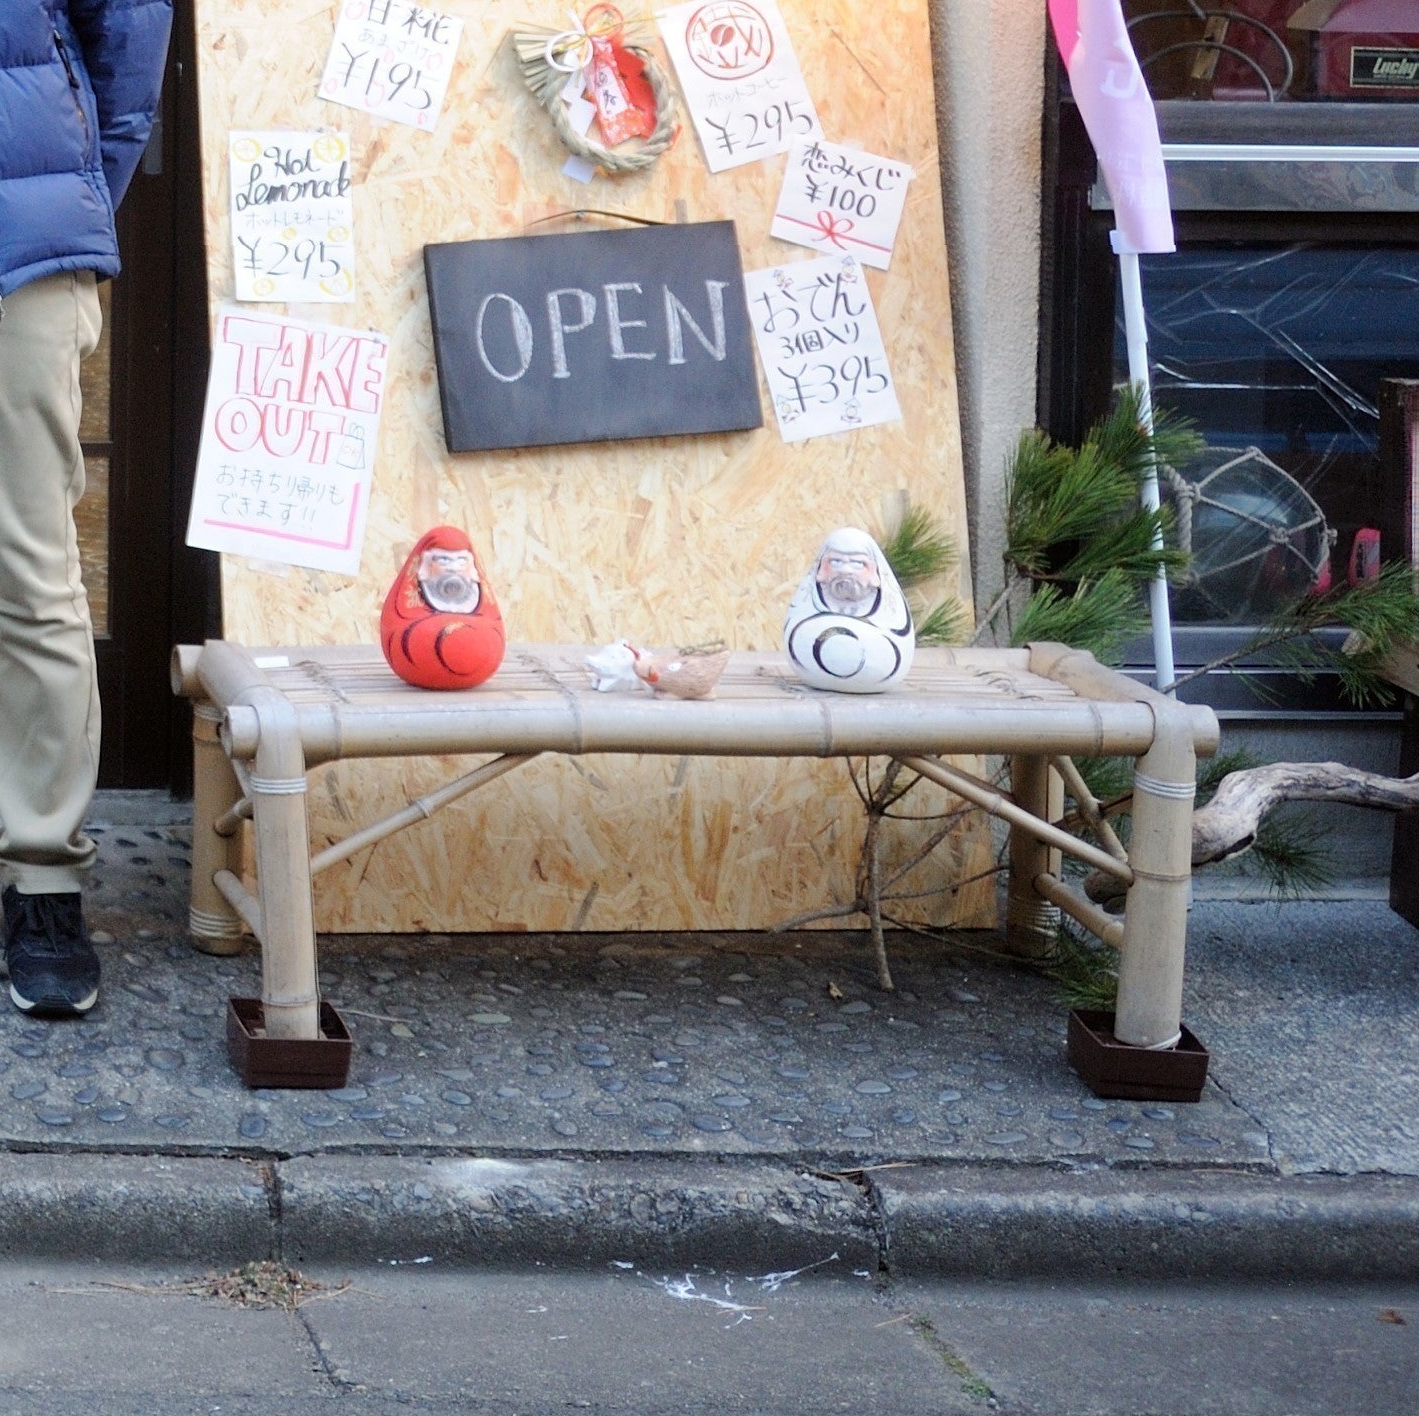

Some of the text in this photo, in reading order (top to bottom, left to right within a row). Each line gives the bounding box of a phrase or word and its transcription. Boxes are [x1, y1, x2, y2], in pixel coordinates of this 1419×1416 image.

[337, 41, 441, 111] ¥195
[704, 100, 814, 156] ¥295
[235, 163, 352, 212] Lemonade
[801, 142, 902, 192] 恋みくじ
[244, 210, 345, 230] ホットレモネード
[804, 173, 877, 218] ¥100
[237, 234, 347, 280] ¥295
[476, 279, 731, 384] OPEN
[753, 273, 867, 334] おでん
[223, 315, 388, 415] TAKE
[779, 322, 860, 360] 3個入り
[776, 355, 890, 413] ¥395
[214, 396, 347, 465] OUT
